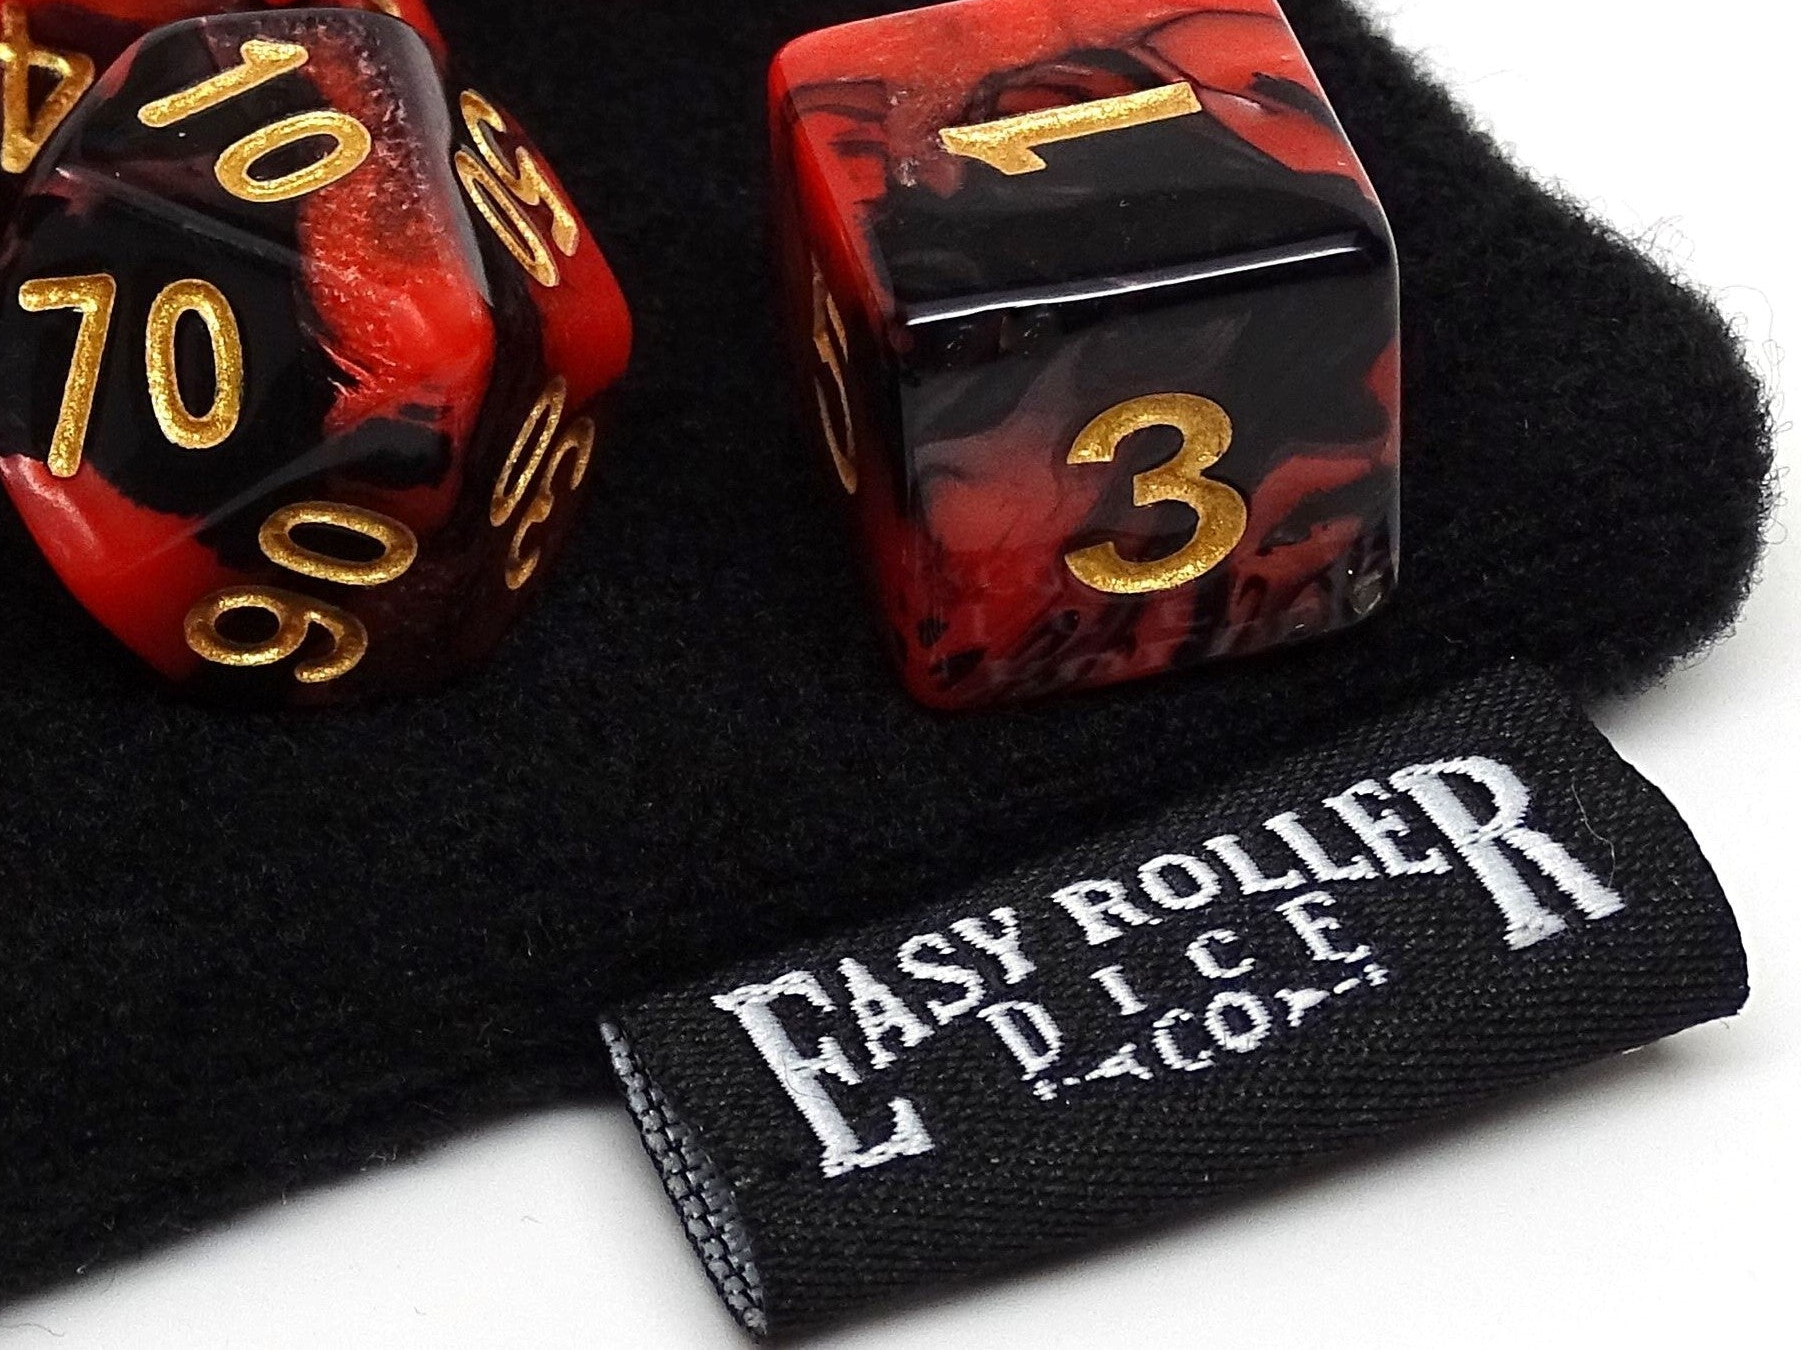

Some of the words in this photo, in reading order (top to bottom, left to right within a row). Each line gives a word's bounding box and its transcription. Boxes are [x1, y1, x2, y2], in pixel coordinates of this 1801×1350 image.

[137, 37, 372, 204] 10
[937, 80, 1203, 176] 1
[17, 273, 244, 478] 70
[488, 375, 596, 591] 30
[1063, 391, 1249, 595] 3
[710, 906, 1038, 1180] EASY
[1050, 755, 1626, 951] ROLLER
[977, 890, 1374, 1082] DICE
